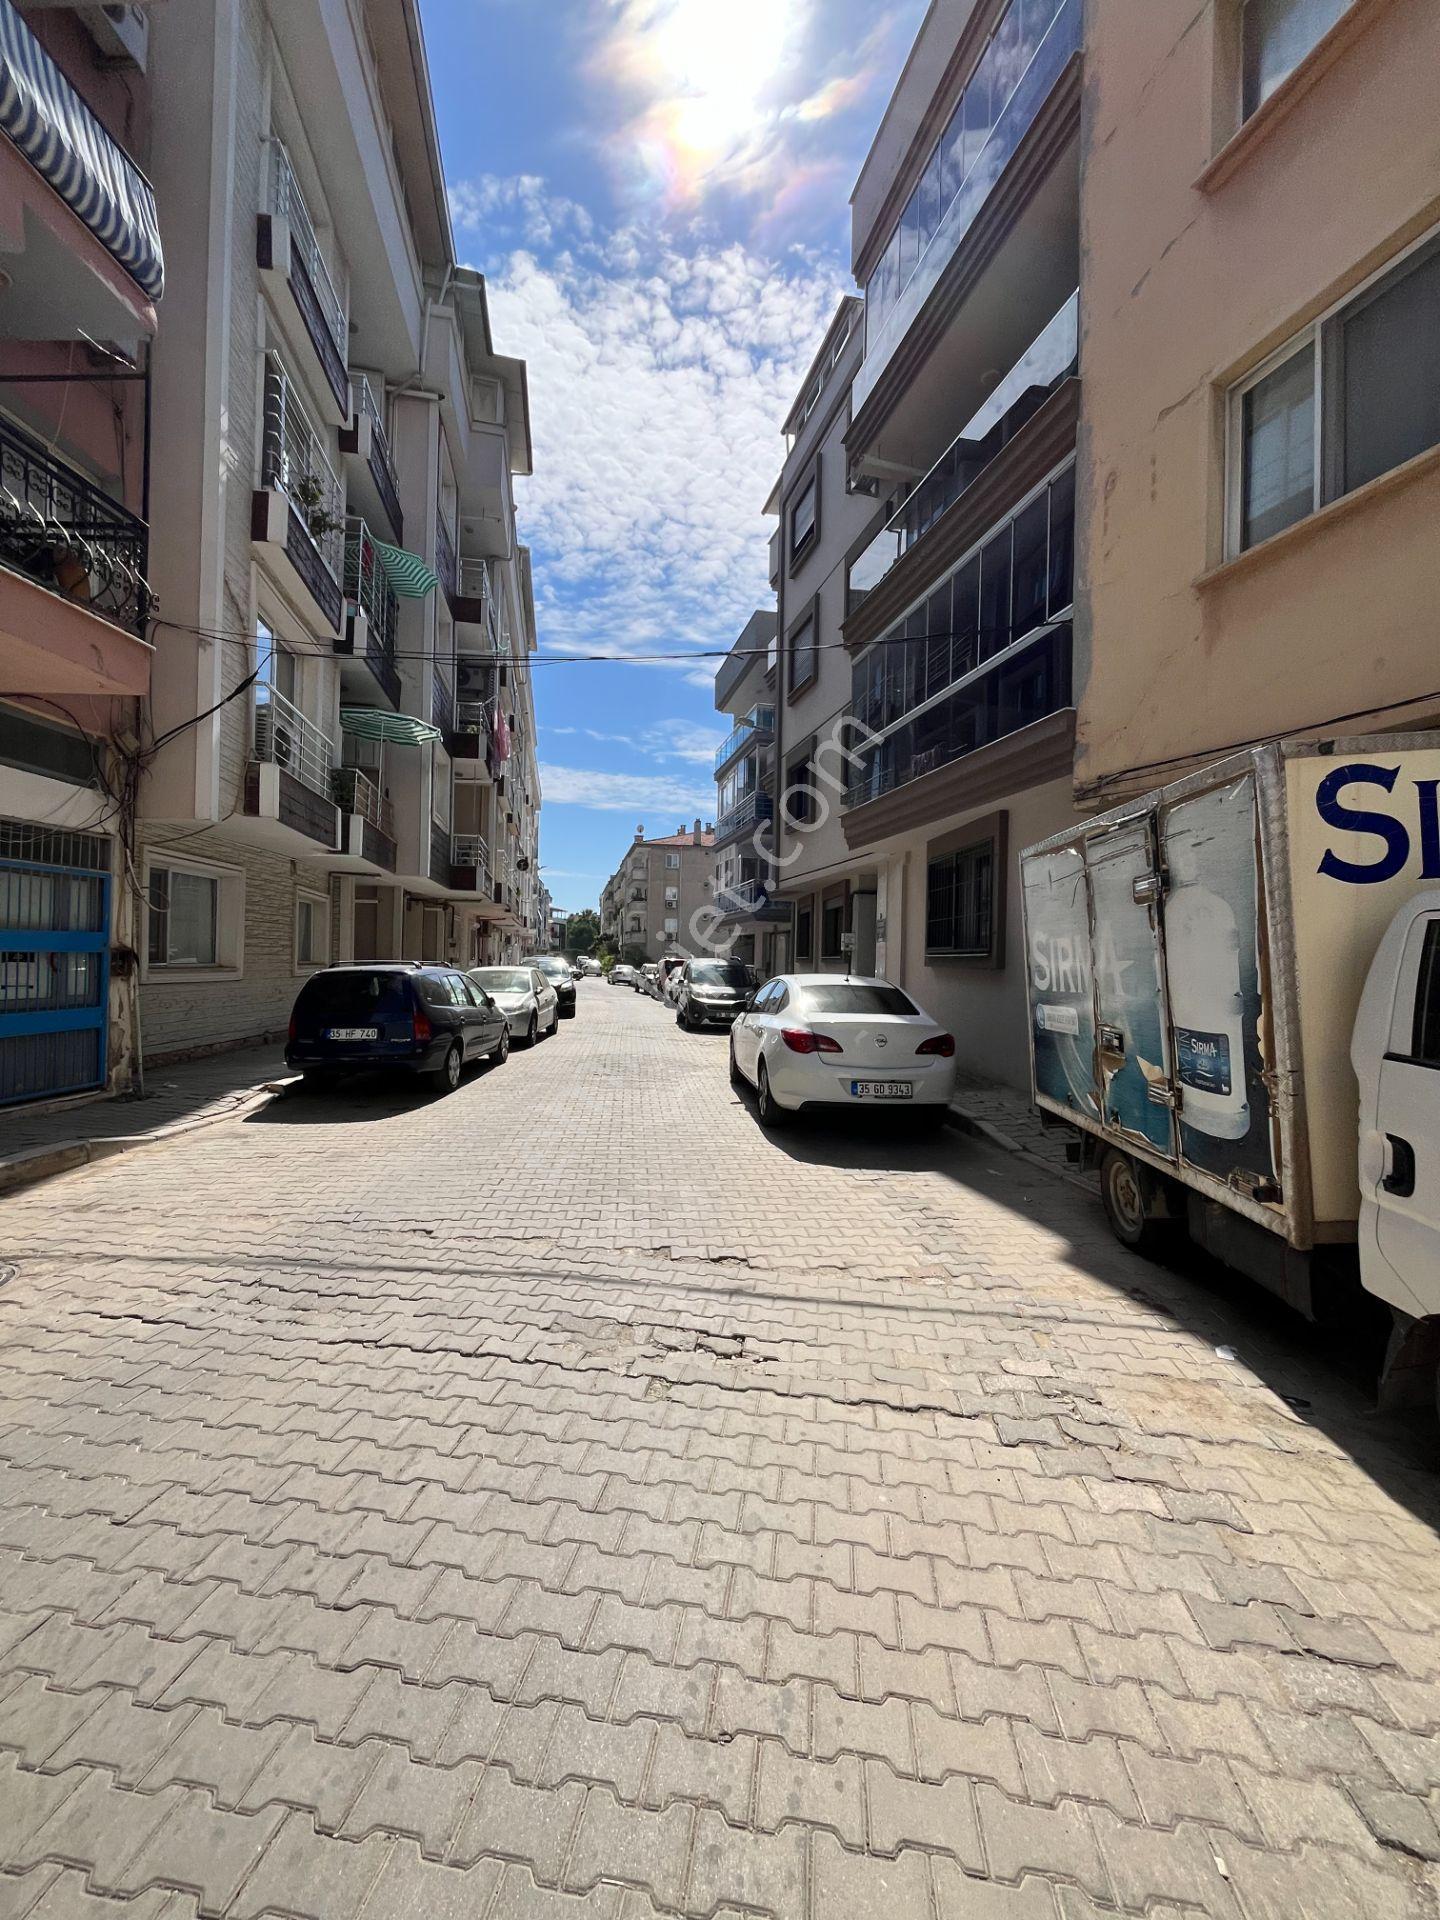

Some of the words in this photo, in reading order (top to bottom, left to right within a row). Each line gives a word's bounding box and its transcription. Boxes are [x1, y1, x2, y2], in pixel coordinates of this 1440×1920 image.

[331, 1029, 341, 1039] 35
[345, 1029, 357, 1039] HF
[360, 1029, 376, 1039] 740
[859, 1084, 870, 1094] 35
[873, 1084, 885, 1094] GD
[888, 1084, 910, 1095] 9343
